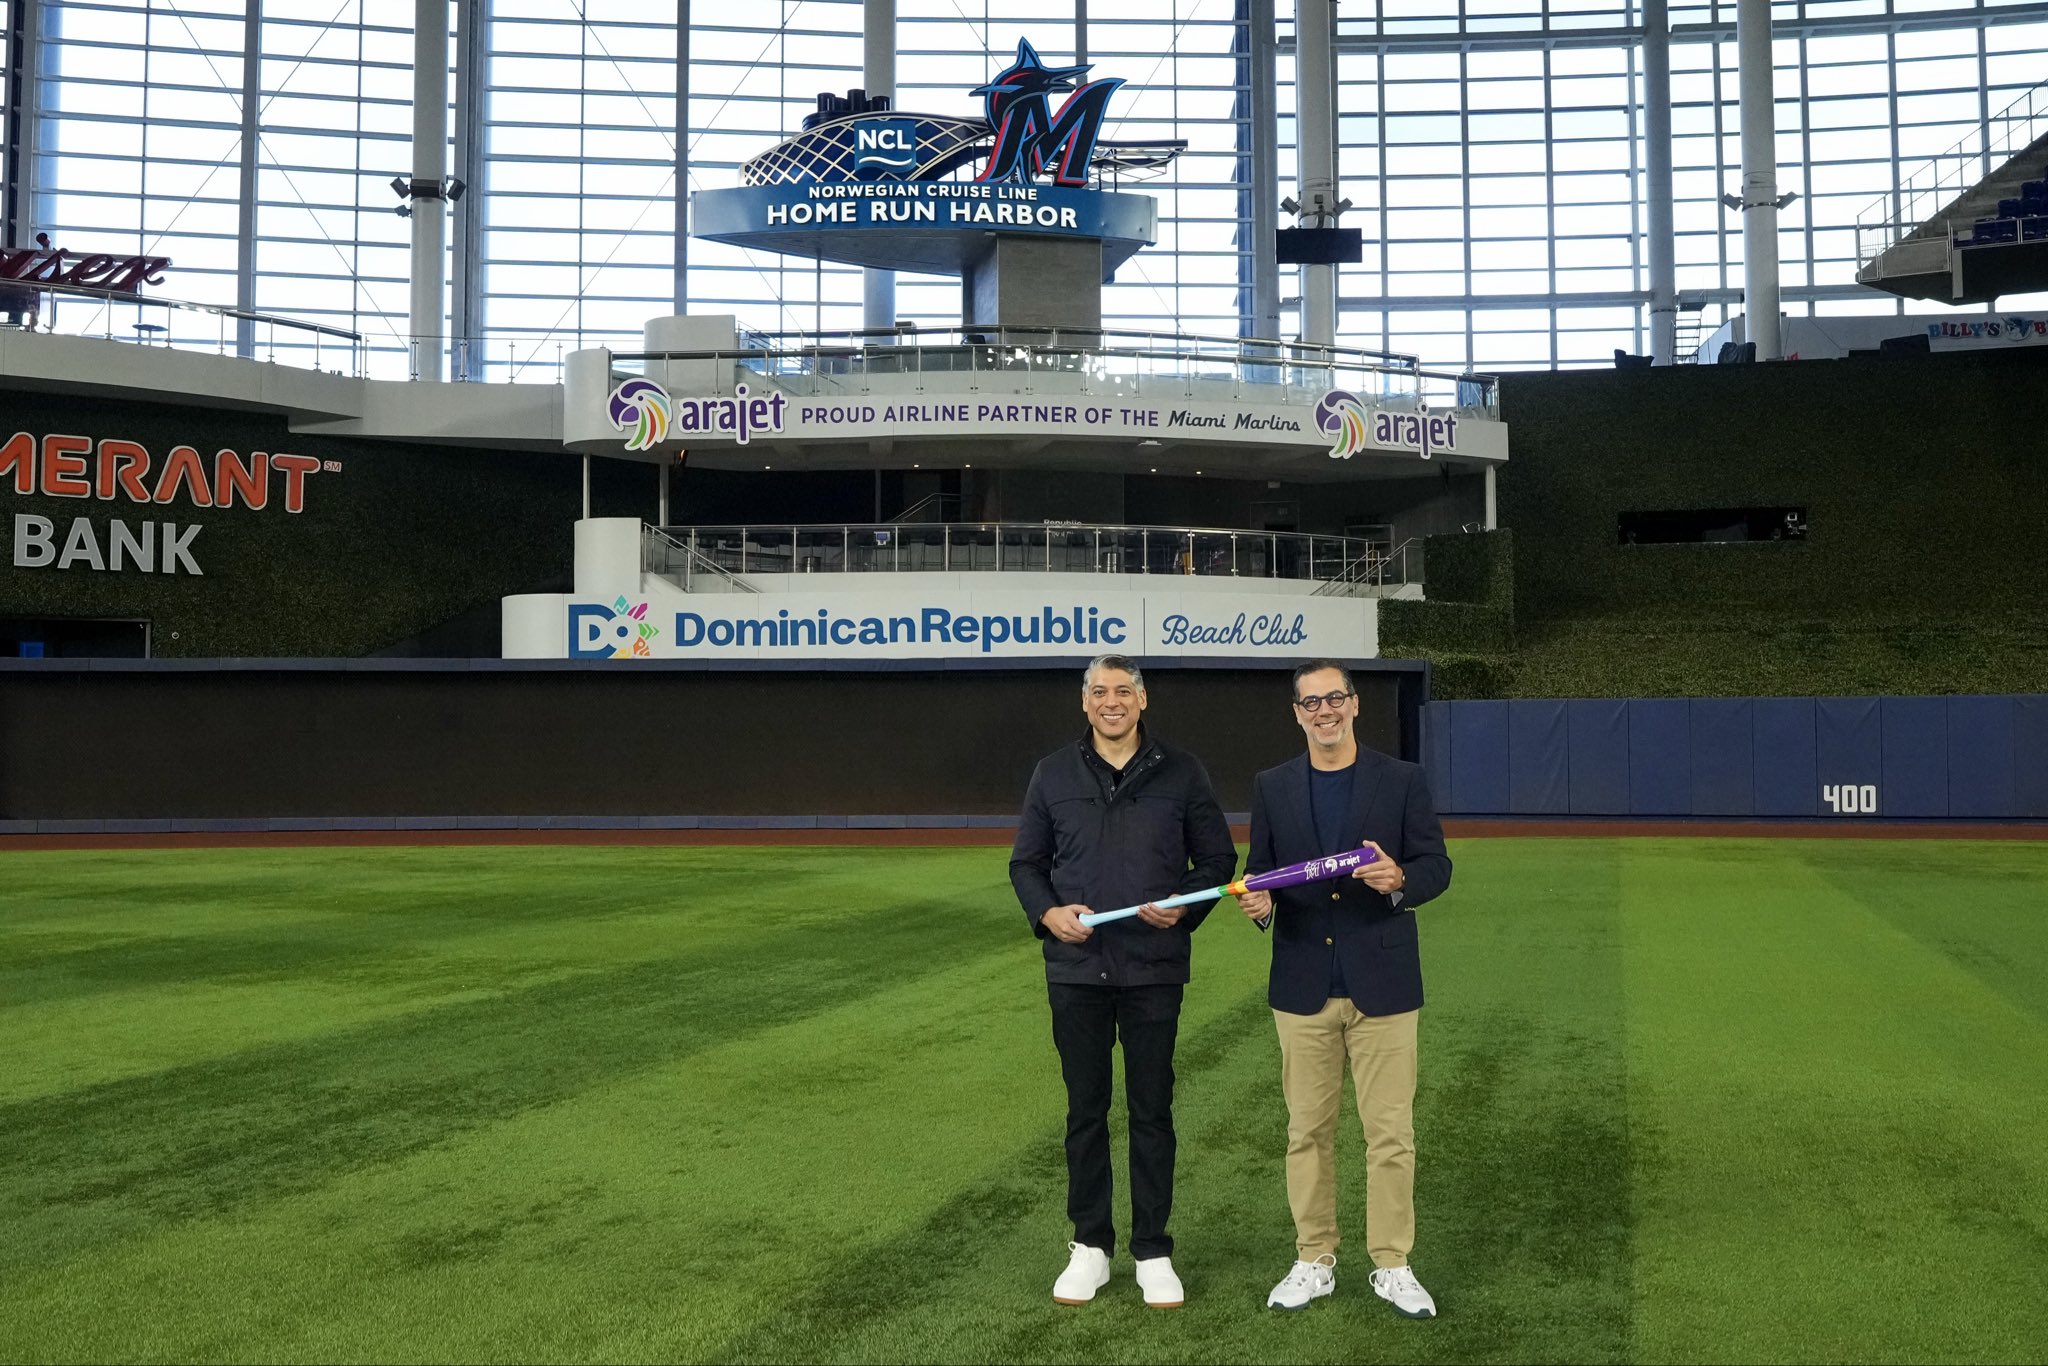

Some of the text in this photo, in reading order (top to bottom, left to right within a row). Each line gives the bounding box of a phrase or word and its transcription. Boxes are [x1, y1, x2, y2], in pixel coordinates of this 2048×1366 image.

[857, 129, 912, 151] NCL
[808, 184, 1038, 201] NORWEGIAN CRUISE LINE
[766, 201, 1078, 229] HOME RUN HARBOR
[1928, 321, 2001, 338] BILLY'S
[681, 386, 786, 442] arajet
[801, 404, 1301, 432] PROUD AIRLINE PARTNER OF THE Miami Marlins
[1376, 404, 1457, 457] arajet
[13, 513, 204, 576] BANK
[1161, 611, 1247, 646] Beach
[1250, 612, 1308, 646] Club
[1823, 784, 1877, 813] 400
[1339, 854, 1361, 867] arajet
